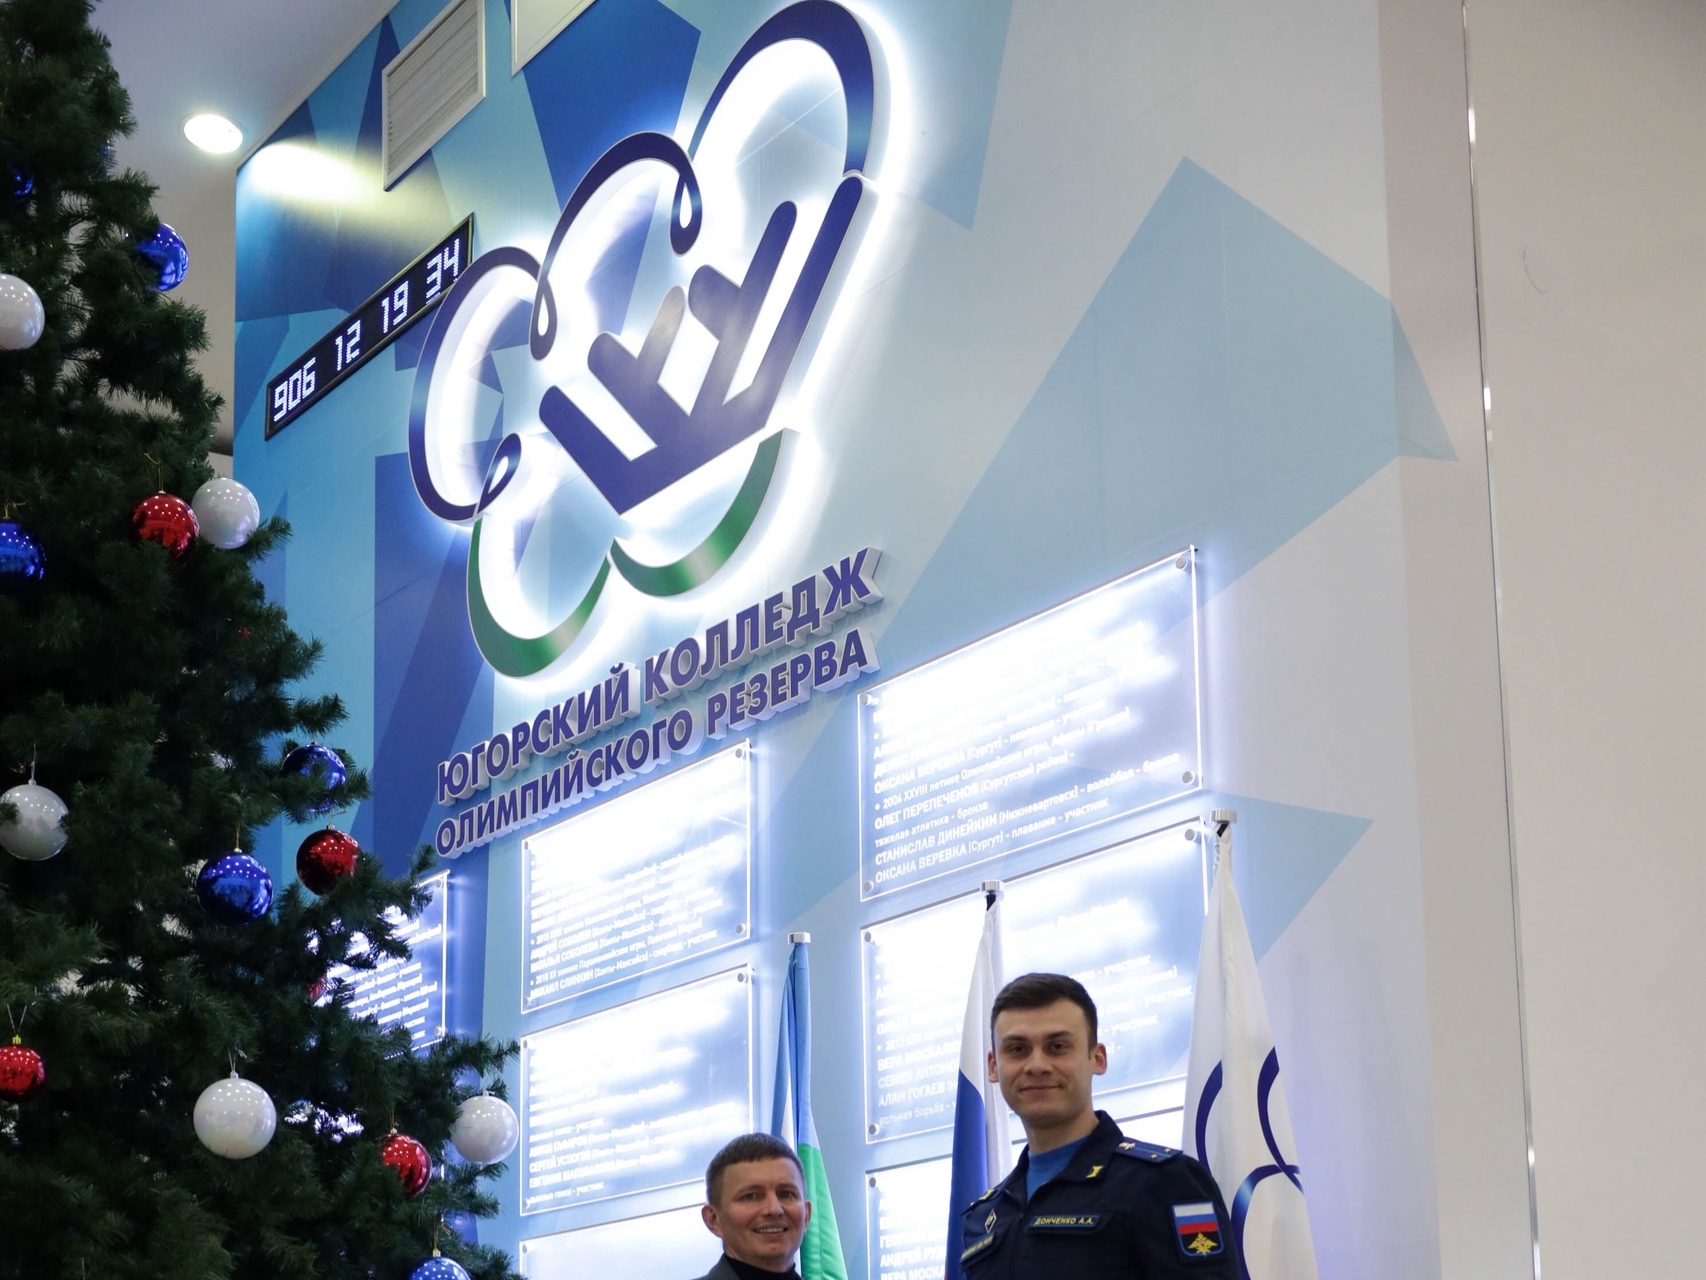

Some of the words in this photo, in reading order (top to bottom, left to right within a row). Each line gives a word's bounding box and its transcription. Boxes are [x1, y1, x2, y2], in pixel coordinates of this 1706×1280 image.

[274, 357, 316, 422] 906
[335, 320, 361, 371] 12
[382, 281, 408, 333] 19
[425, 238, 459, 299] 34
[437, 661, 630, 804] ЮГОРСКИЙ
[644, 547, 872, 702] КОЛЛЕДЖ
[435, 708, 694, 857] ОЛИМПИЙСКОГО
[707, 628, 869, 736] РЕЗЕРВА
[874, 809, 901, 830] ОЛЕГ
[874, 828, 910, 848] тяжелая
[911, 815, 949, 836] атлетика
[957, 801, 989, 820] бронза
[883, 794, 902, 809] 2004
[875, 835, 935, 866] СТАНИСЛАВ
[937, 814, 998, 847] ДИНЕЙКИН
[875, 860, 917, 883] ОКСАНА
[918, 843, 967, 870] ВЕРЕВКА
[1012, 815, 1056, 838] плавание
[1064, 798, 1109, 823] участник
[915, 1058, 960, 1081] АНТОНО
[1034, 1216, 1077, 1226] ДОНЧЕНКО
[1078, 1216, 1094, 1225] А.А.
